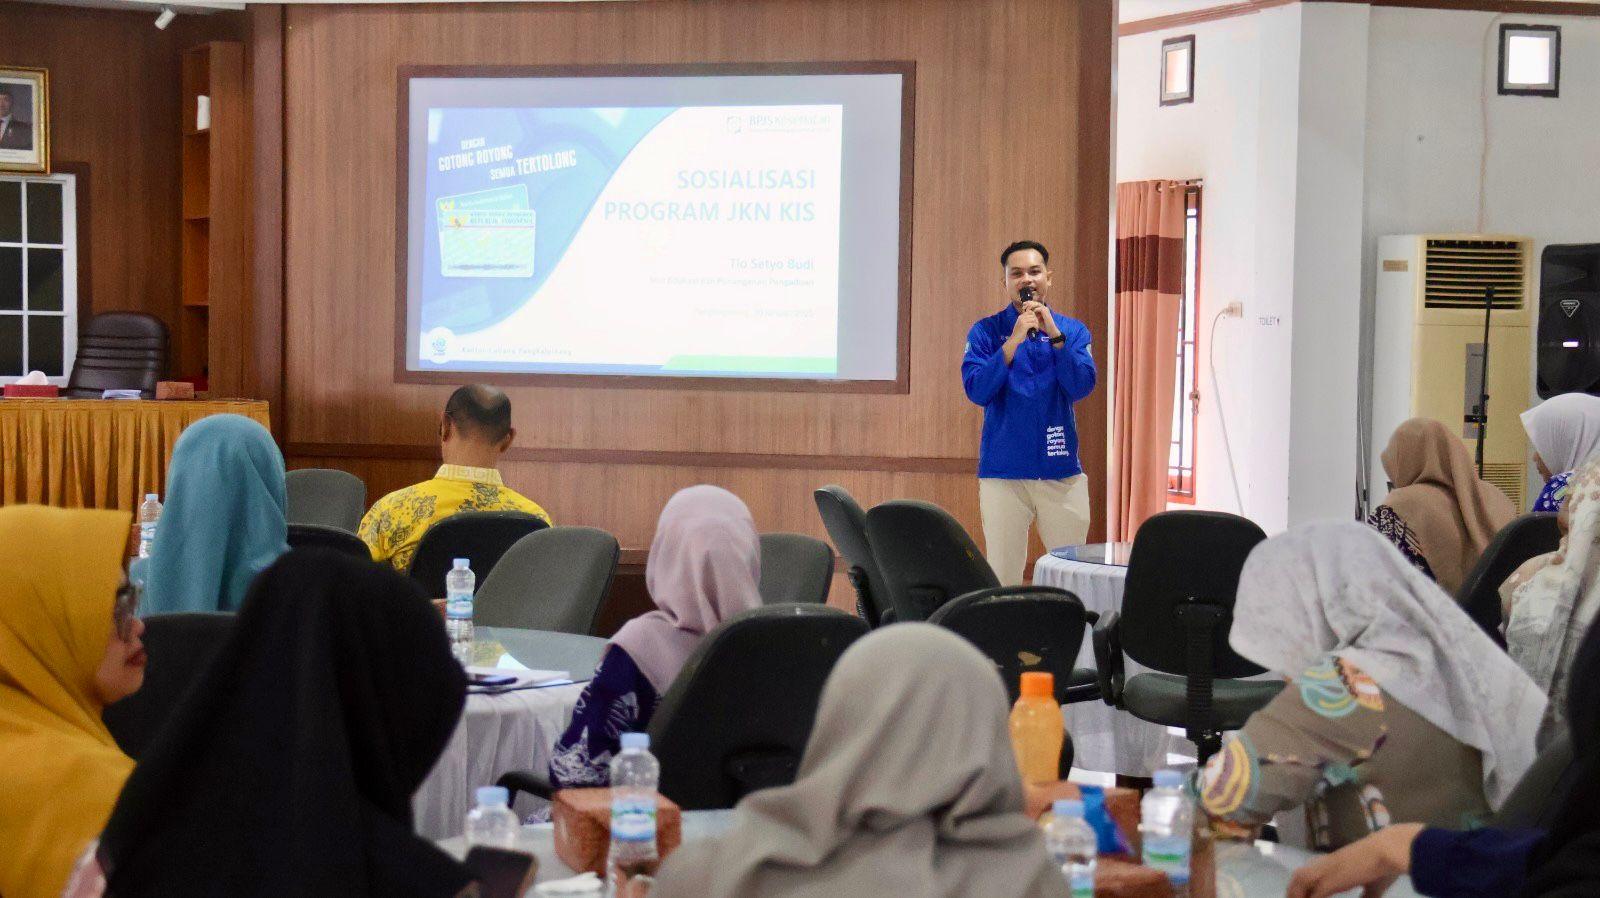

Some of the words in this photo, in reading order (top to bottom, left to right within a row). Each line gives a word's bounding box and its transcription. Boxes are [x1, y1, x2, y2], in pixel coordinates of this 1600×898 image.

[438, 152, 474, 172] GOTONG
[477, 144, 514, 165] ROYONG
[489, 166, 516, 180] SEMUA
[516, 150, 577, 175] TERTOLONG
[677, 169, 815, 189] SOSIALISASI
[604, 202, 719, 222] PROGRAM
[726, 202, 771, 222] JKN
[780, 202, 815, 222] KIS
[751, 257, 784, 272] Setyo
[787, 258, 815, 270] Budi
[1258, 316, 1276, 326] TOILET
